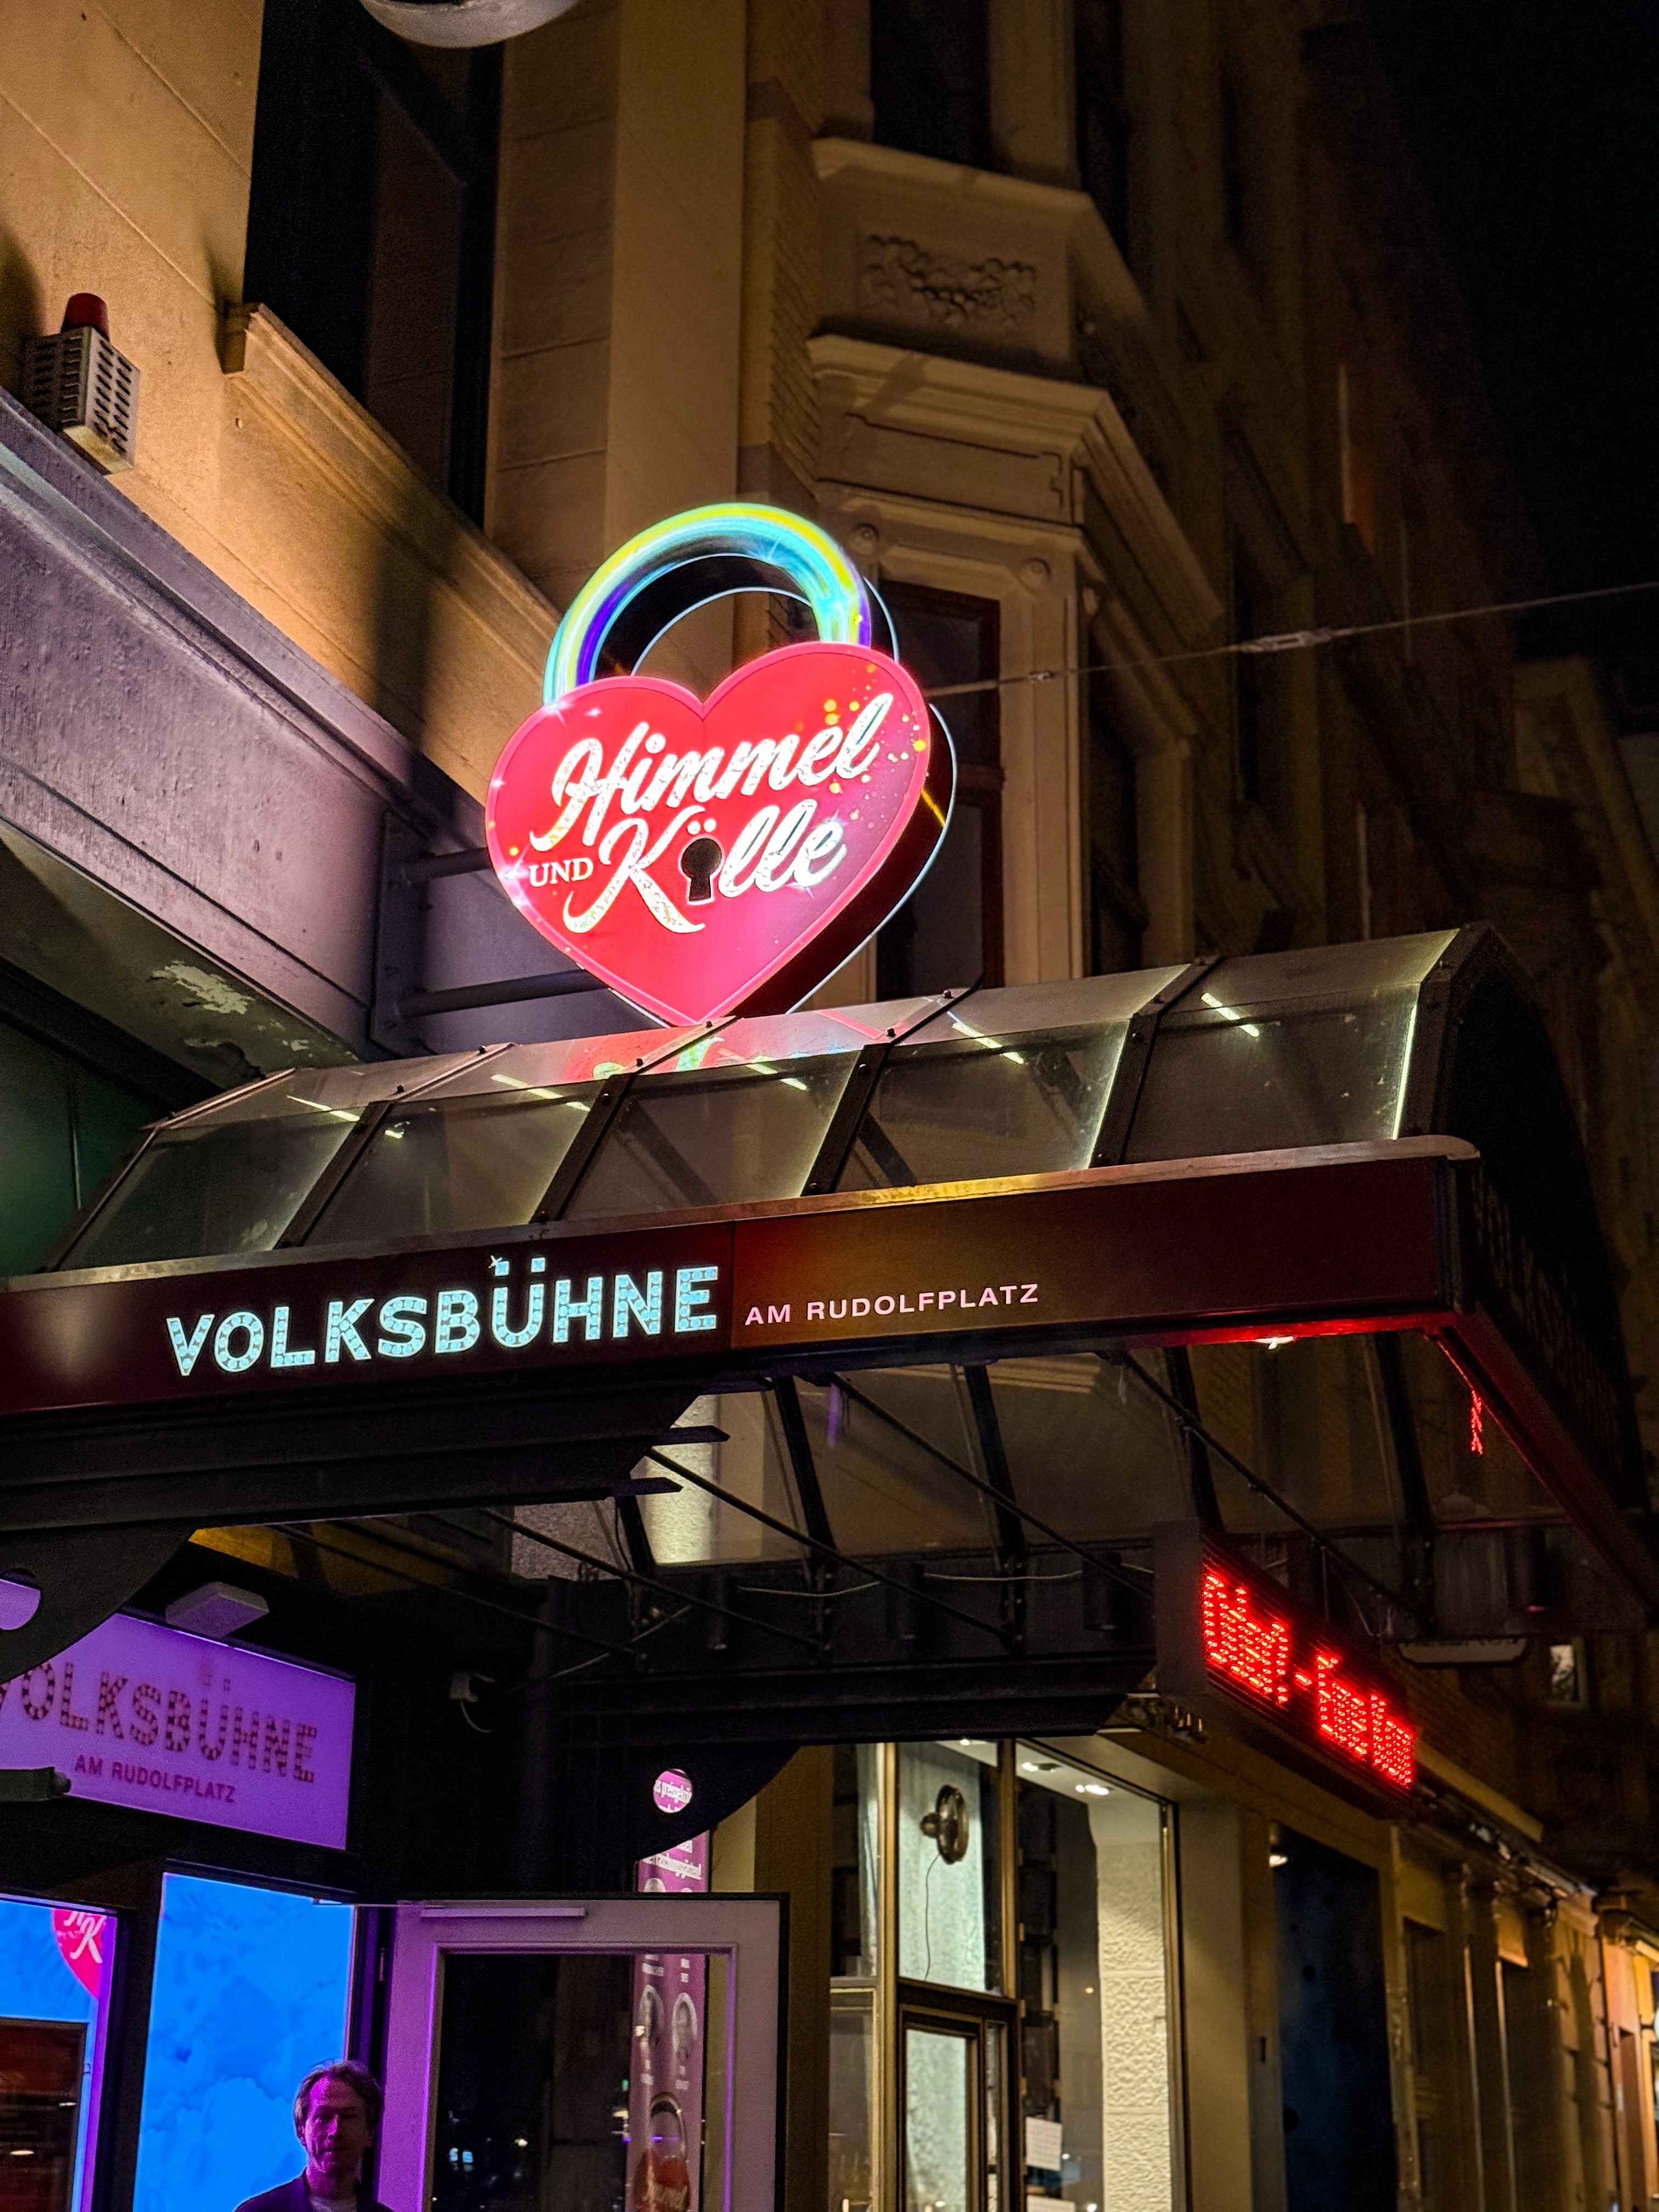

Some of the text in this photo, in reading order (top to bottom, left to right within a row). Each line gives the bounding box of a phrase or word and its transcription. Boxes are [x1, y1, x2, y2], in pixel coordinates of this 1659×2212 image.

[529, 693, 894, 852] Himmel
[529, 799, 848, 934] UND Kölle
[166, 1256, 718, 1375] VOLKSBÜHNE
[745, 1283, 1039, 1325] AM RUDOLFPLATZ
[75, 1754, 235, 1803] AM RUDOLFPLATZ
